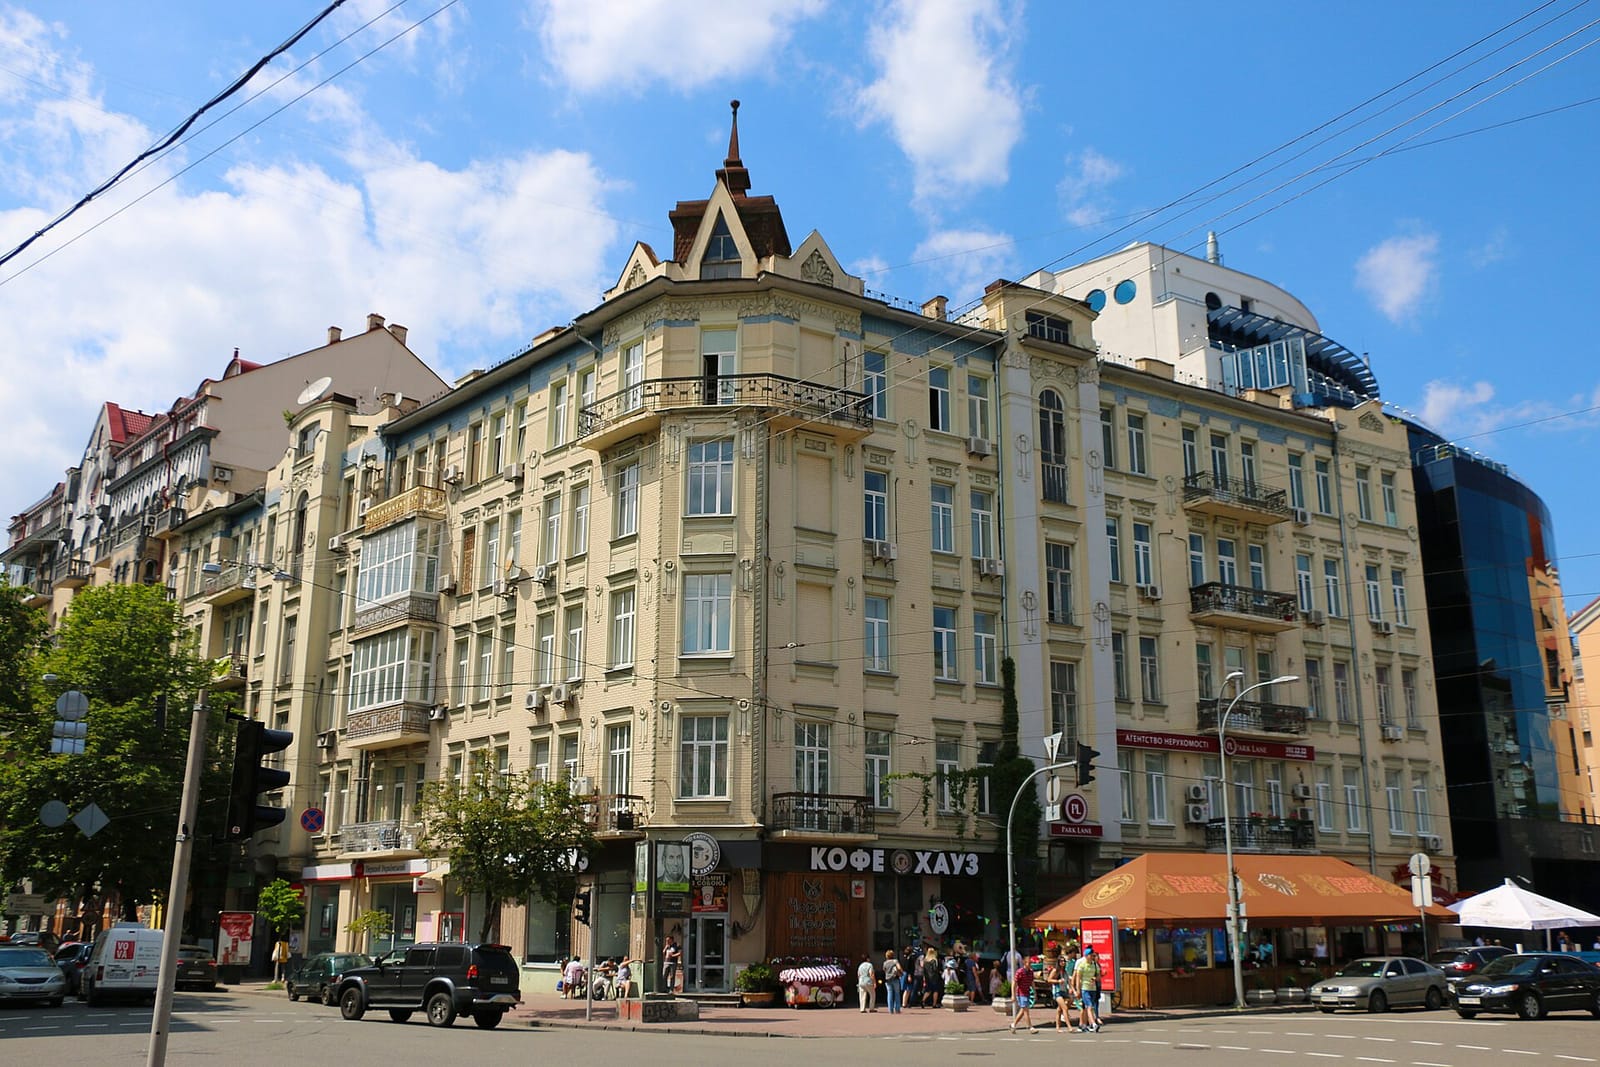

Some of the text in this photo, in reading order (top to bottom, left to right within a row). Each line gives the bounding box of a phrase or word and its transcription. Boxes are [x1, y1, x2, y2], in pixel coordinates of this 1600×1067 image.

[1125, 733, 1209, 749] АГЕНТСТВО НЕРУХОМОСТІ
[1071, 803, 1081, 815] PL
[1061, 825, 1092, 834] PARK LANE
[811, 847, 979, 876] КОФЕ ХАУЗ
[117, 942, 129, 950] VO
[116, 950, 128, 959] VA
